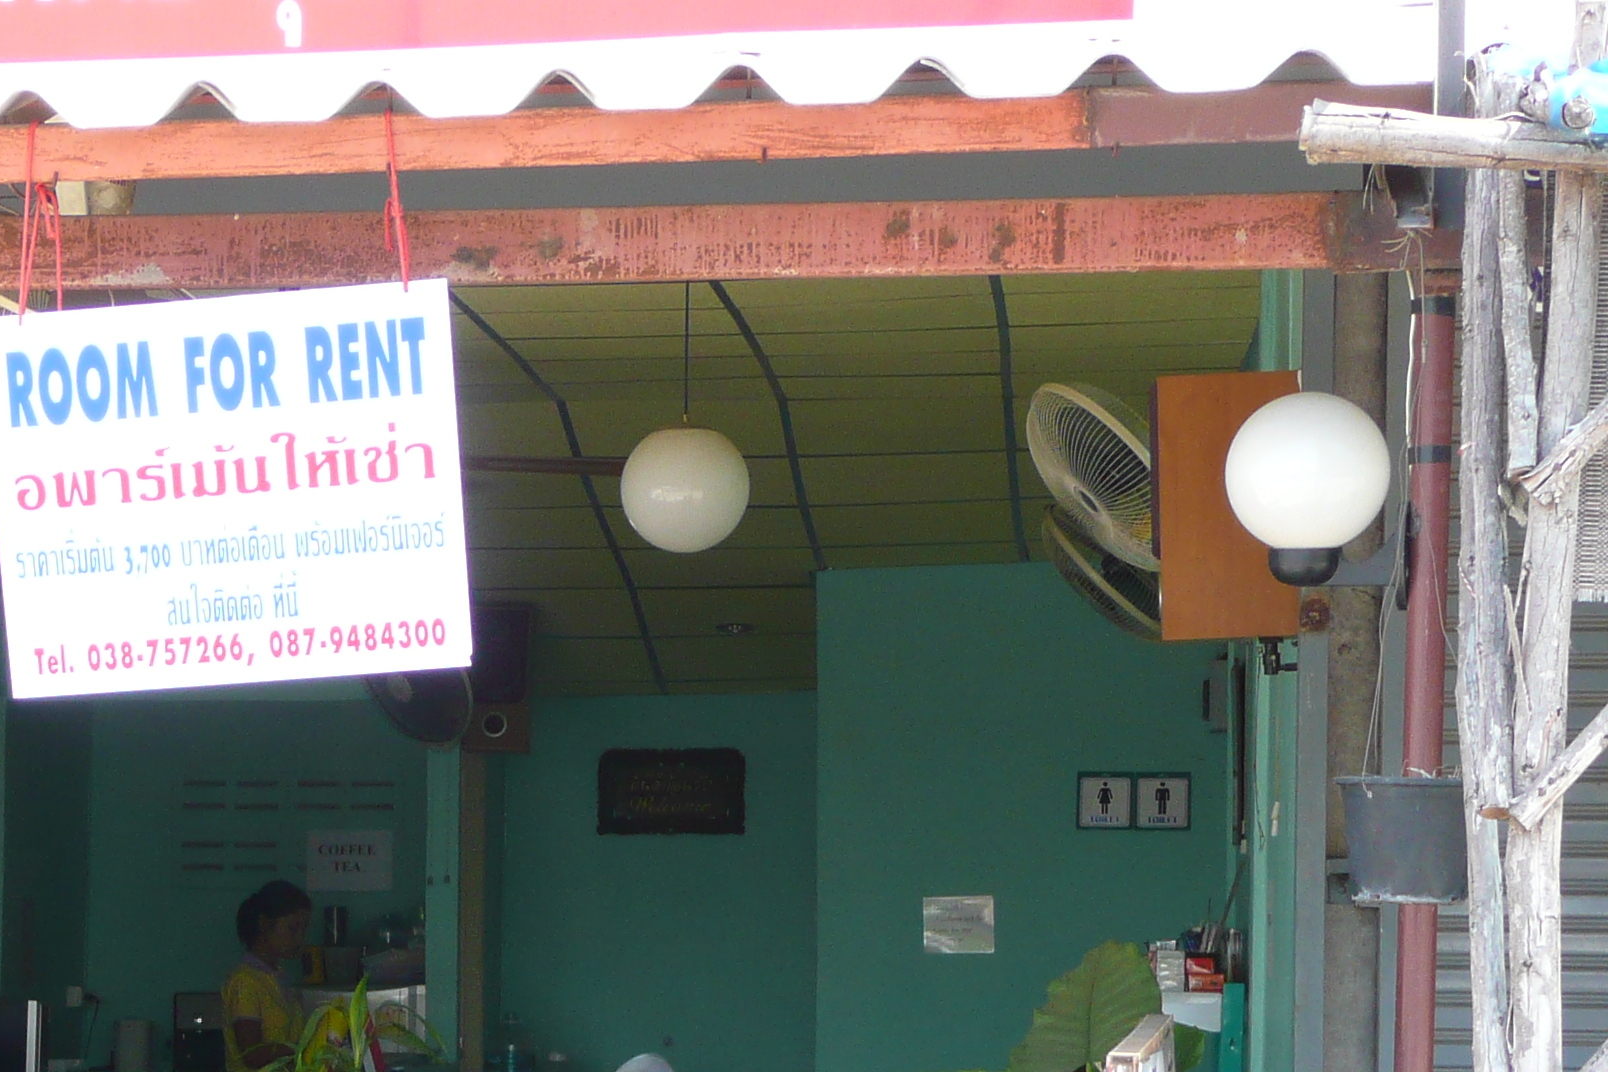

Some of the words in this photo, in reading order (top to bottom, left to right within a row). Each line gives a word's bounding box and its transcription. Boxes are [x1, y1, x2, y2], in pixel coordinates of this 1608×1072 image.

[6, 340, 158, 428] ROOM
[184, 331, 281, 413] FOR
[304, 317, 425, 403] RENT
[124, 543, 171, 577] 3,700
[34, 644, 74, 675] Tel.
[269, 618, 446, 658] 087-9484300
[318, 844, 377, 857] COFFEE
[333, 860, 361, 873] TEA
